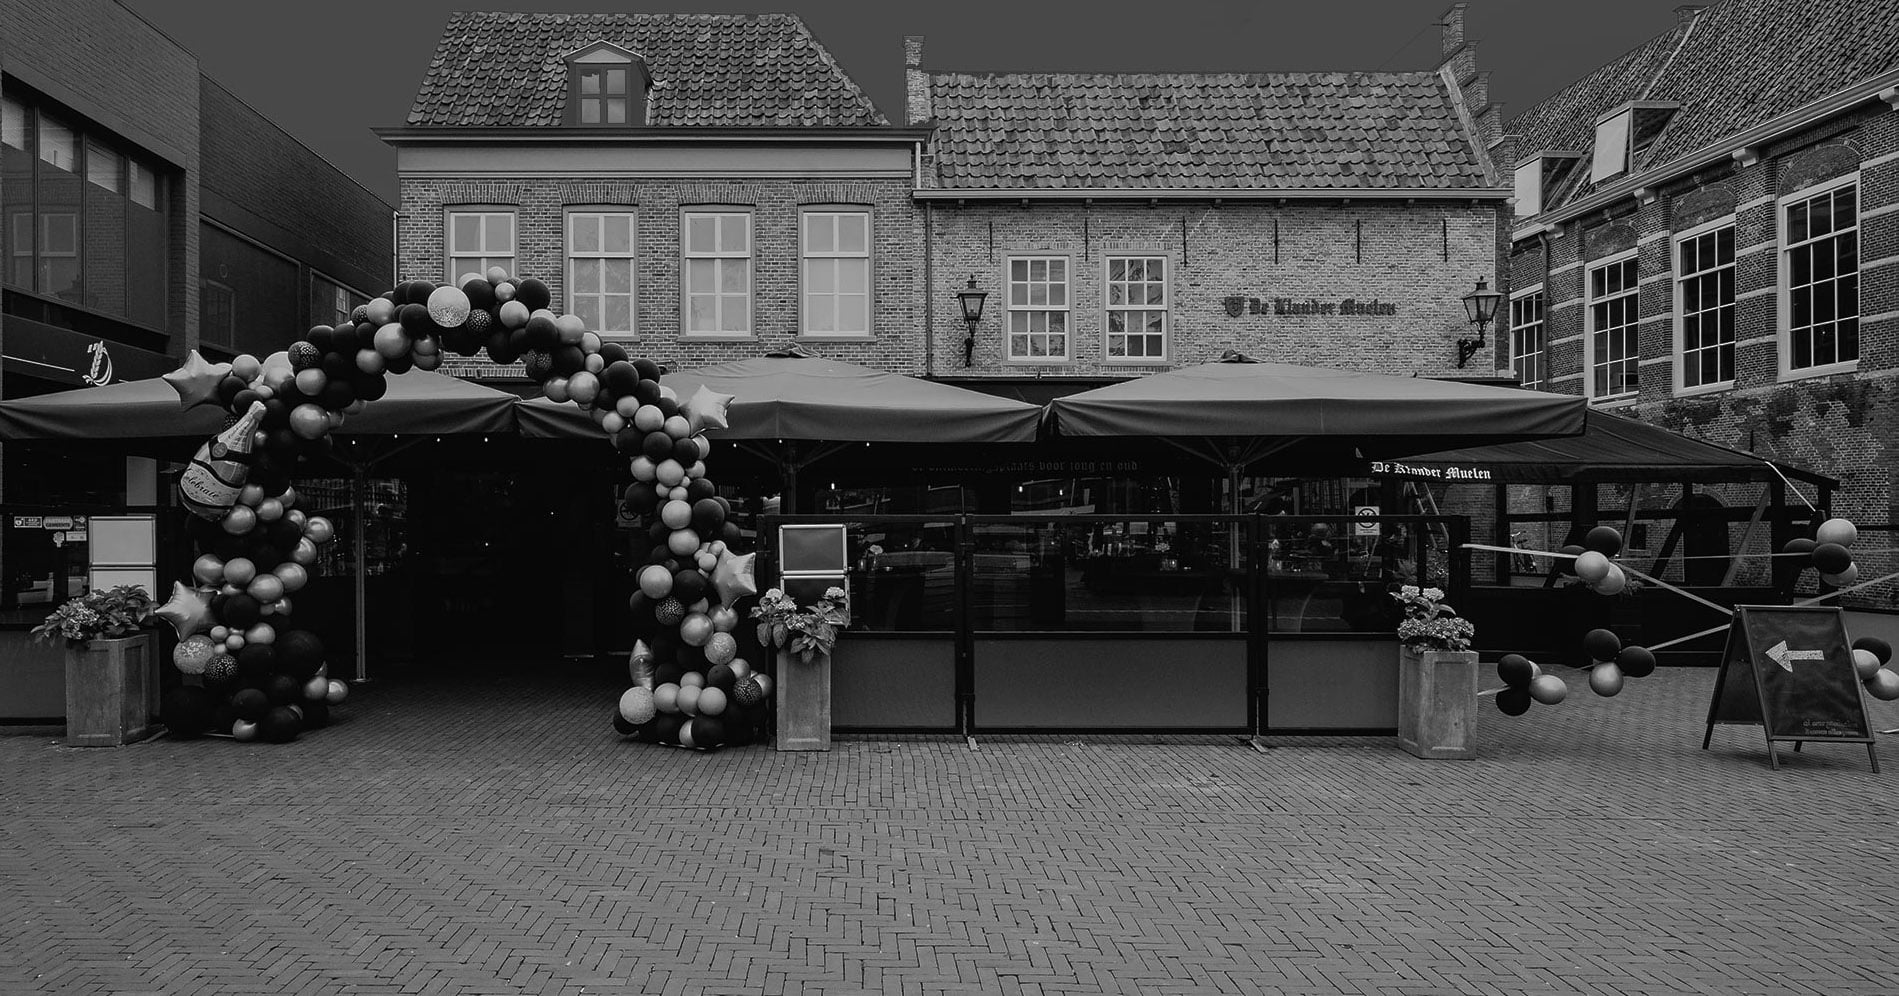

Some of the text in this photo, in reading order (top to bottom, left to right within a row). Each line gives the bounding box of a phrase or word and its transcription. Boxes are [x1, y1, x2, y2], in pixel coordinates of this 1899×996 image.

[1249, 298, 1269, 315] De
[1339, 298, 1396, 316] Muelen
[1039, 461, 1064, 472] voor
[1370, 461, 1391, 474] De
[1445, 467, 1492, 480] Muelen
